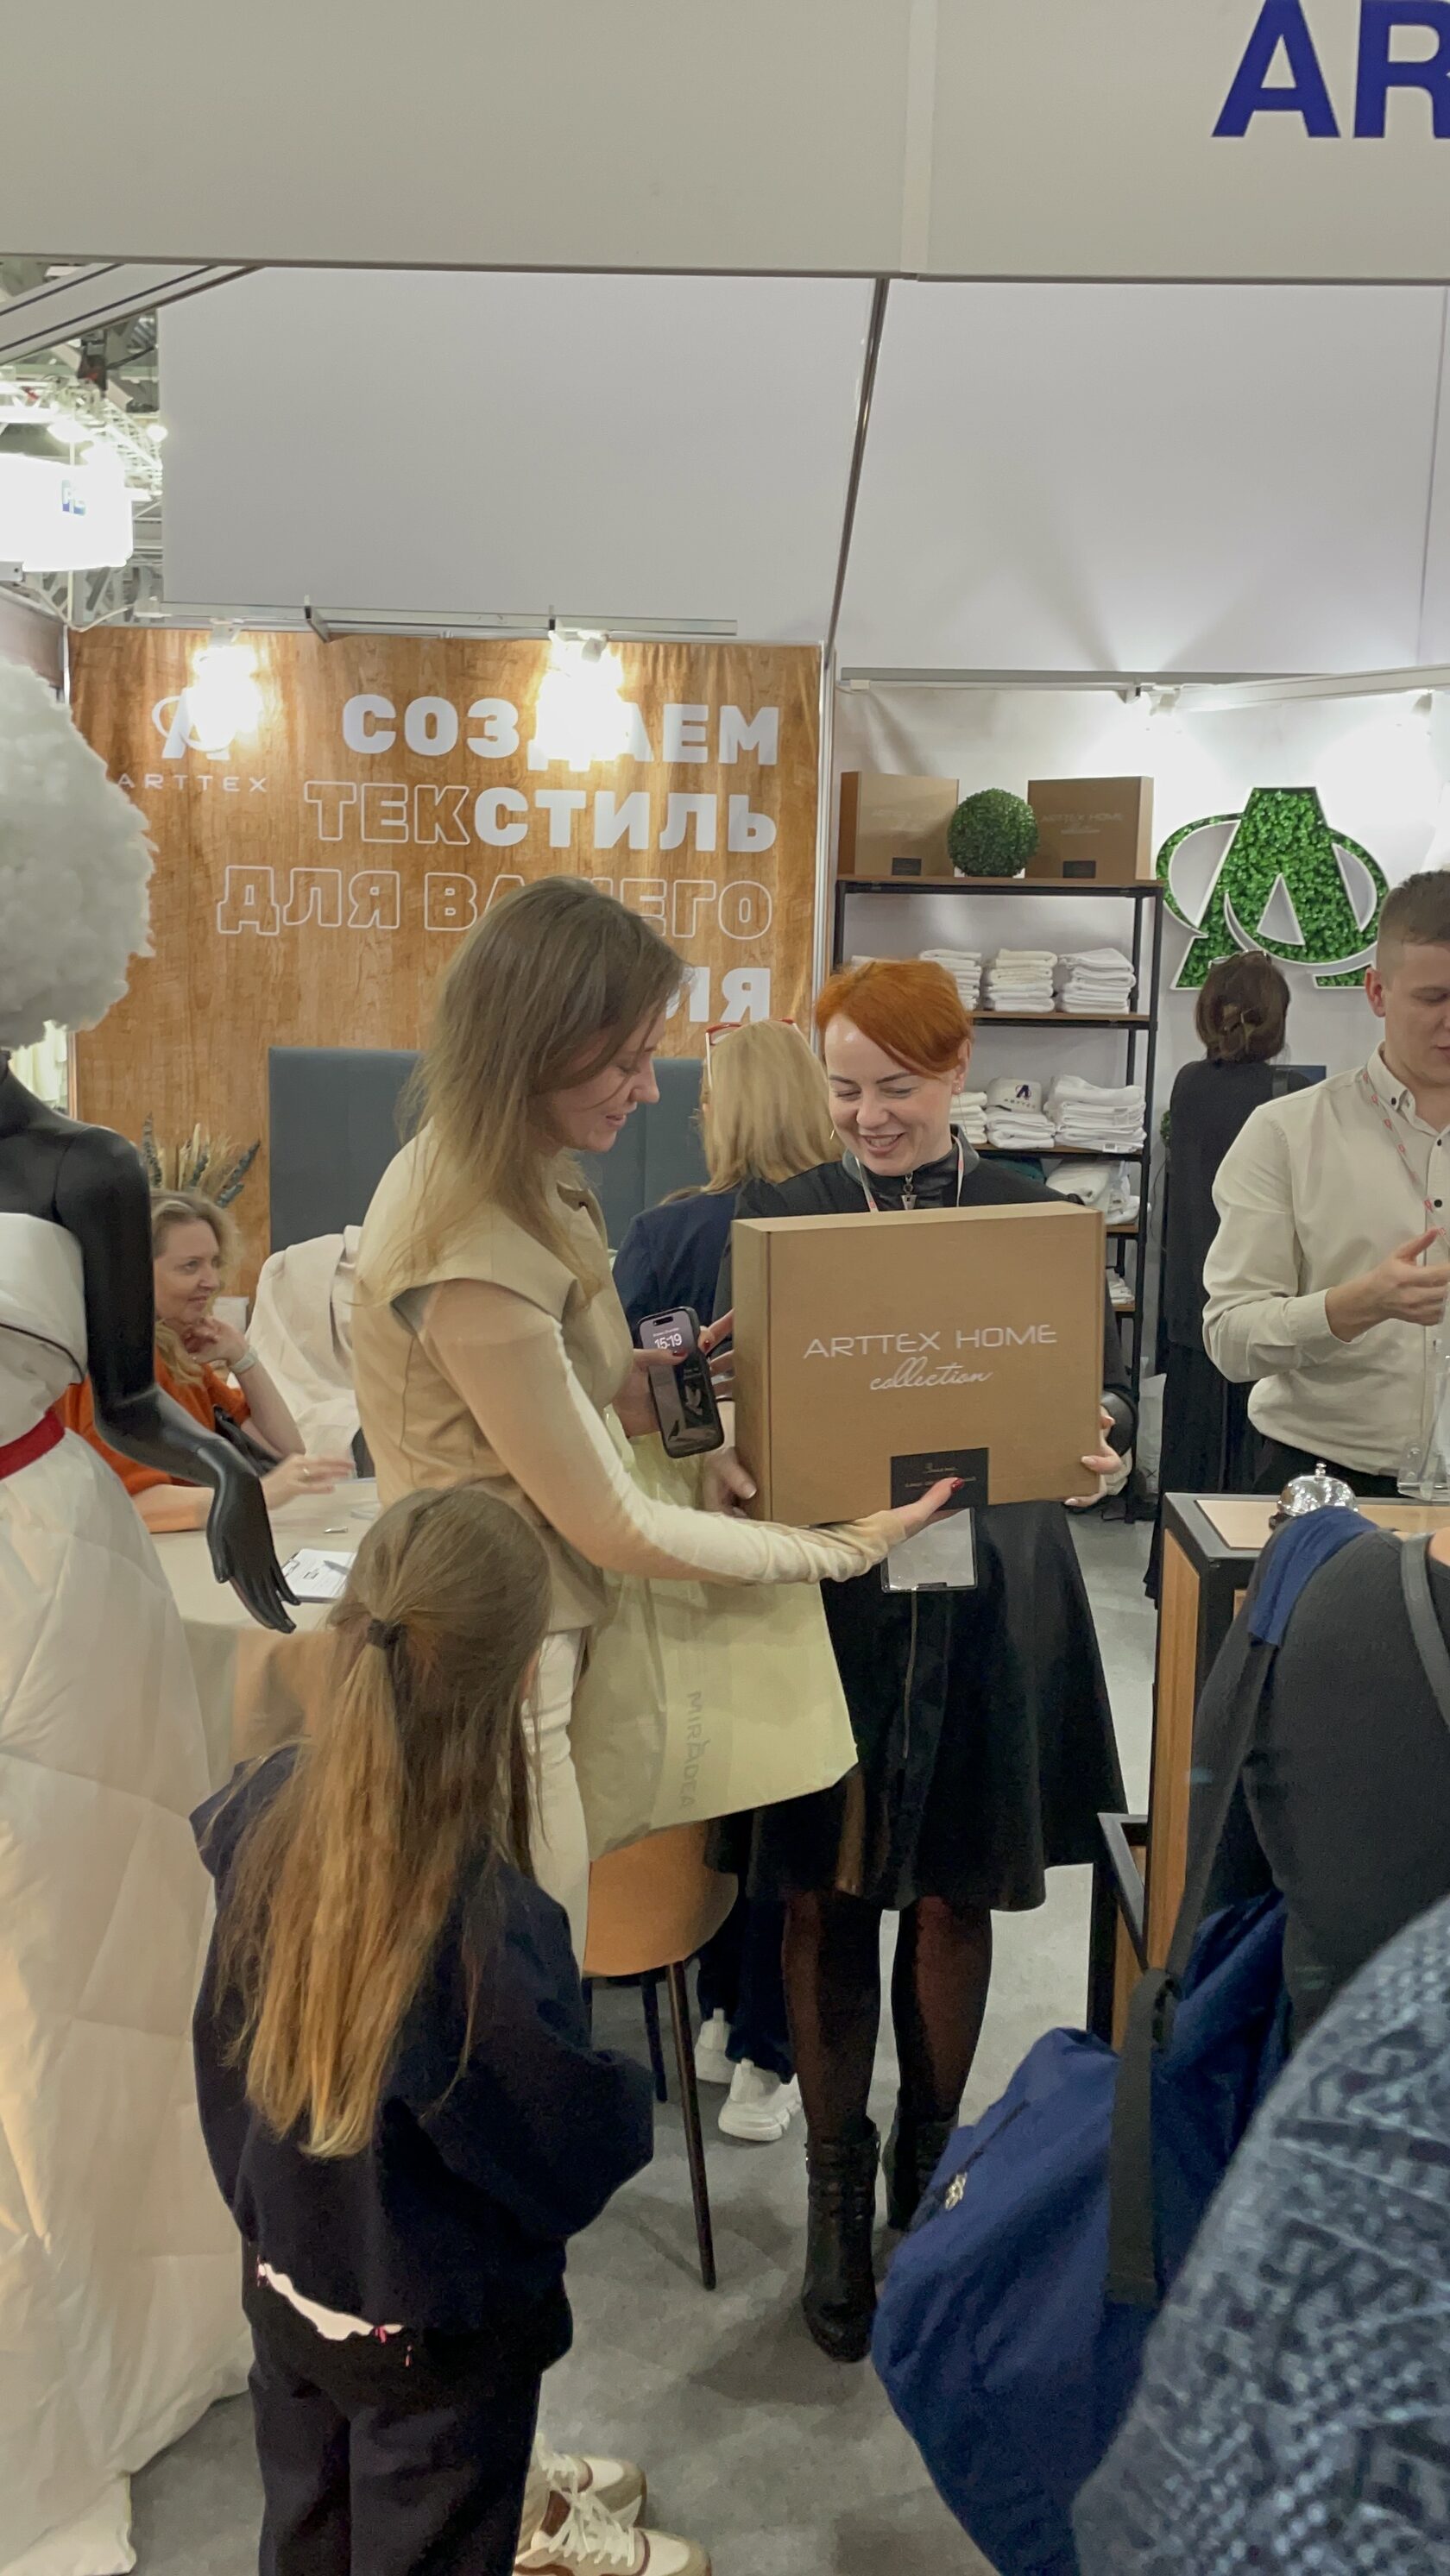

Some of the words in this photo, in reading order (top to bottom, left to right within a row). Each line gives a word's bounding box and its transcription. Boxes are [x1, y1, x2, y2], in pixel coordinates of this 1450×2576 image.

[1210, 0, 1450, 139] AR
[117, 773, 268, 792] ARTTEX
[304, 780, 778, 853] ТЕКСТИЛЬ
[217, 865, 401, 936] ДЛЯ
[424, 872, 773, 941] ВЕГО
[803, 1331, 942, 1359] ARTTEX
[955, 1324, 1058, 1350] HOME
[869, 1356, 993, 1391] collection
